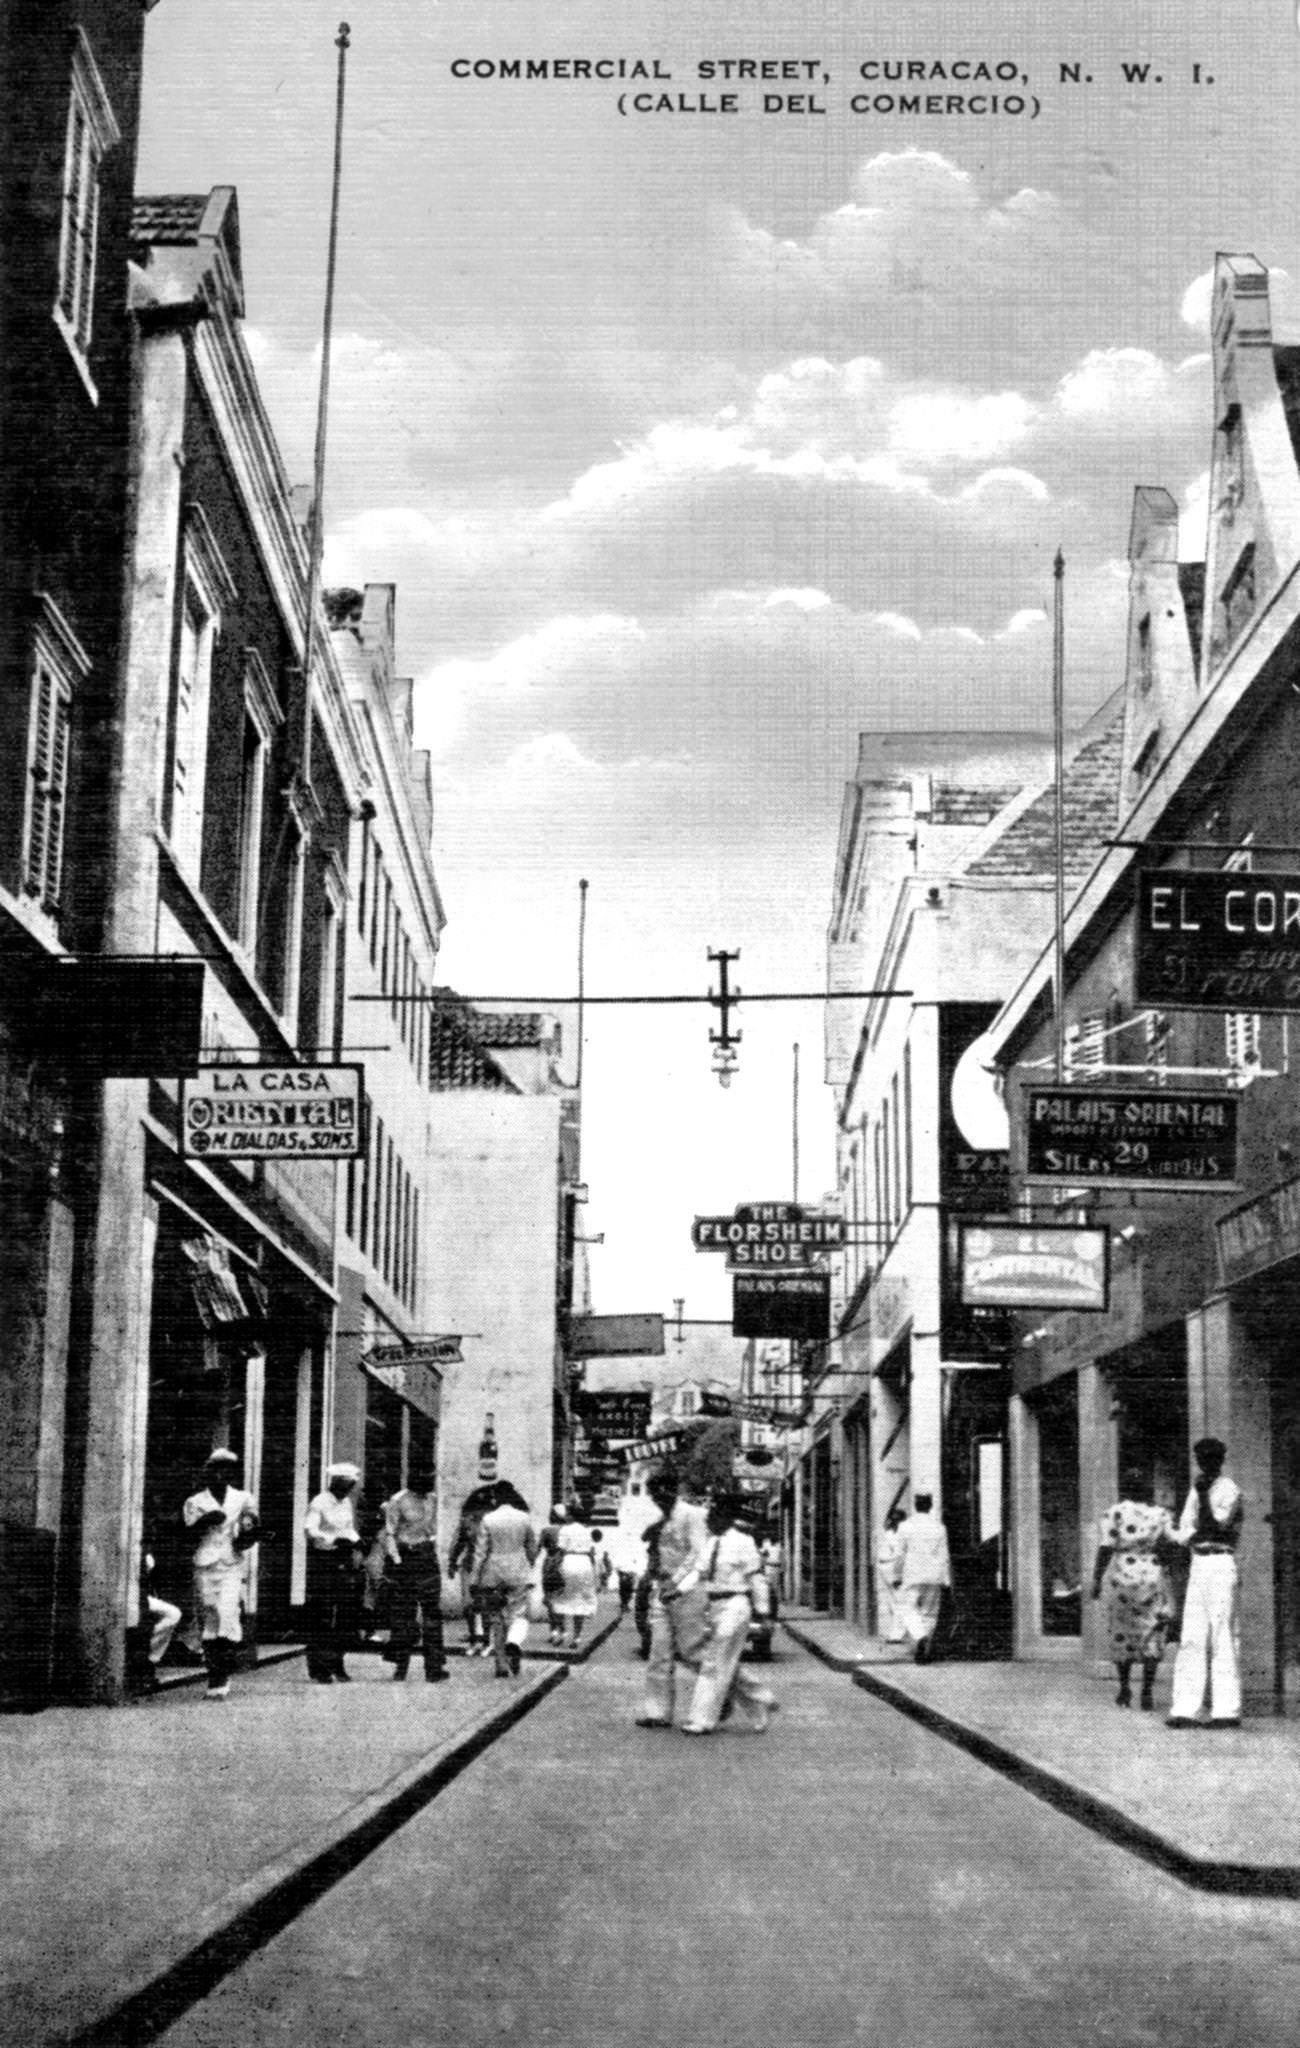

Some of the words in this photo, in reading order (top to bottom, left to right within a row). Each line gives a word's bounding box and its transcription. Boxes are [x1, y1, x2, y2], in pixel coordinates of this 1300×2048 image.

[1152, 886, 1200, 930] EL
[213, 1072, 248, 1091] LA
[260, 1072, 330, 1091] CASA
[188, 1097, 355, 1129] ORIENTAL
[1113, 1141, 1150, 1164] 29
[751, 1205, 788, 1220] THE
[699, 1222, 841, 1242] FLORSHEIM
[735, 1244, 804, 1262] SHOE
